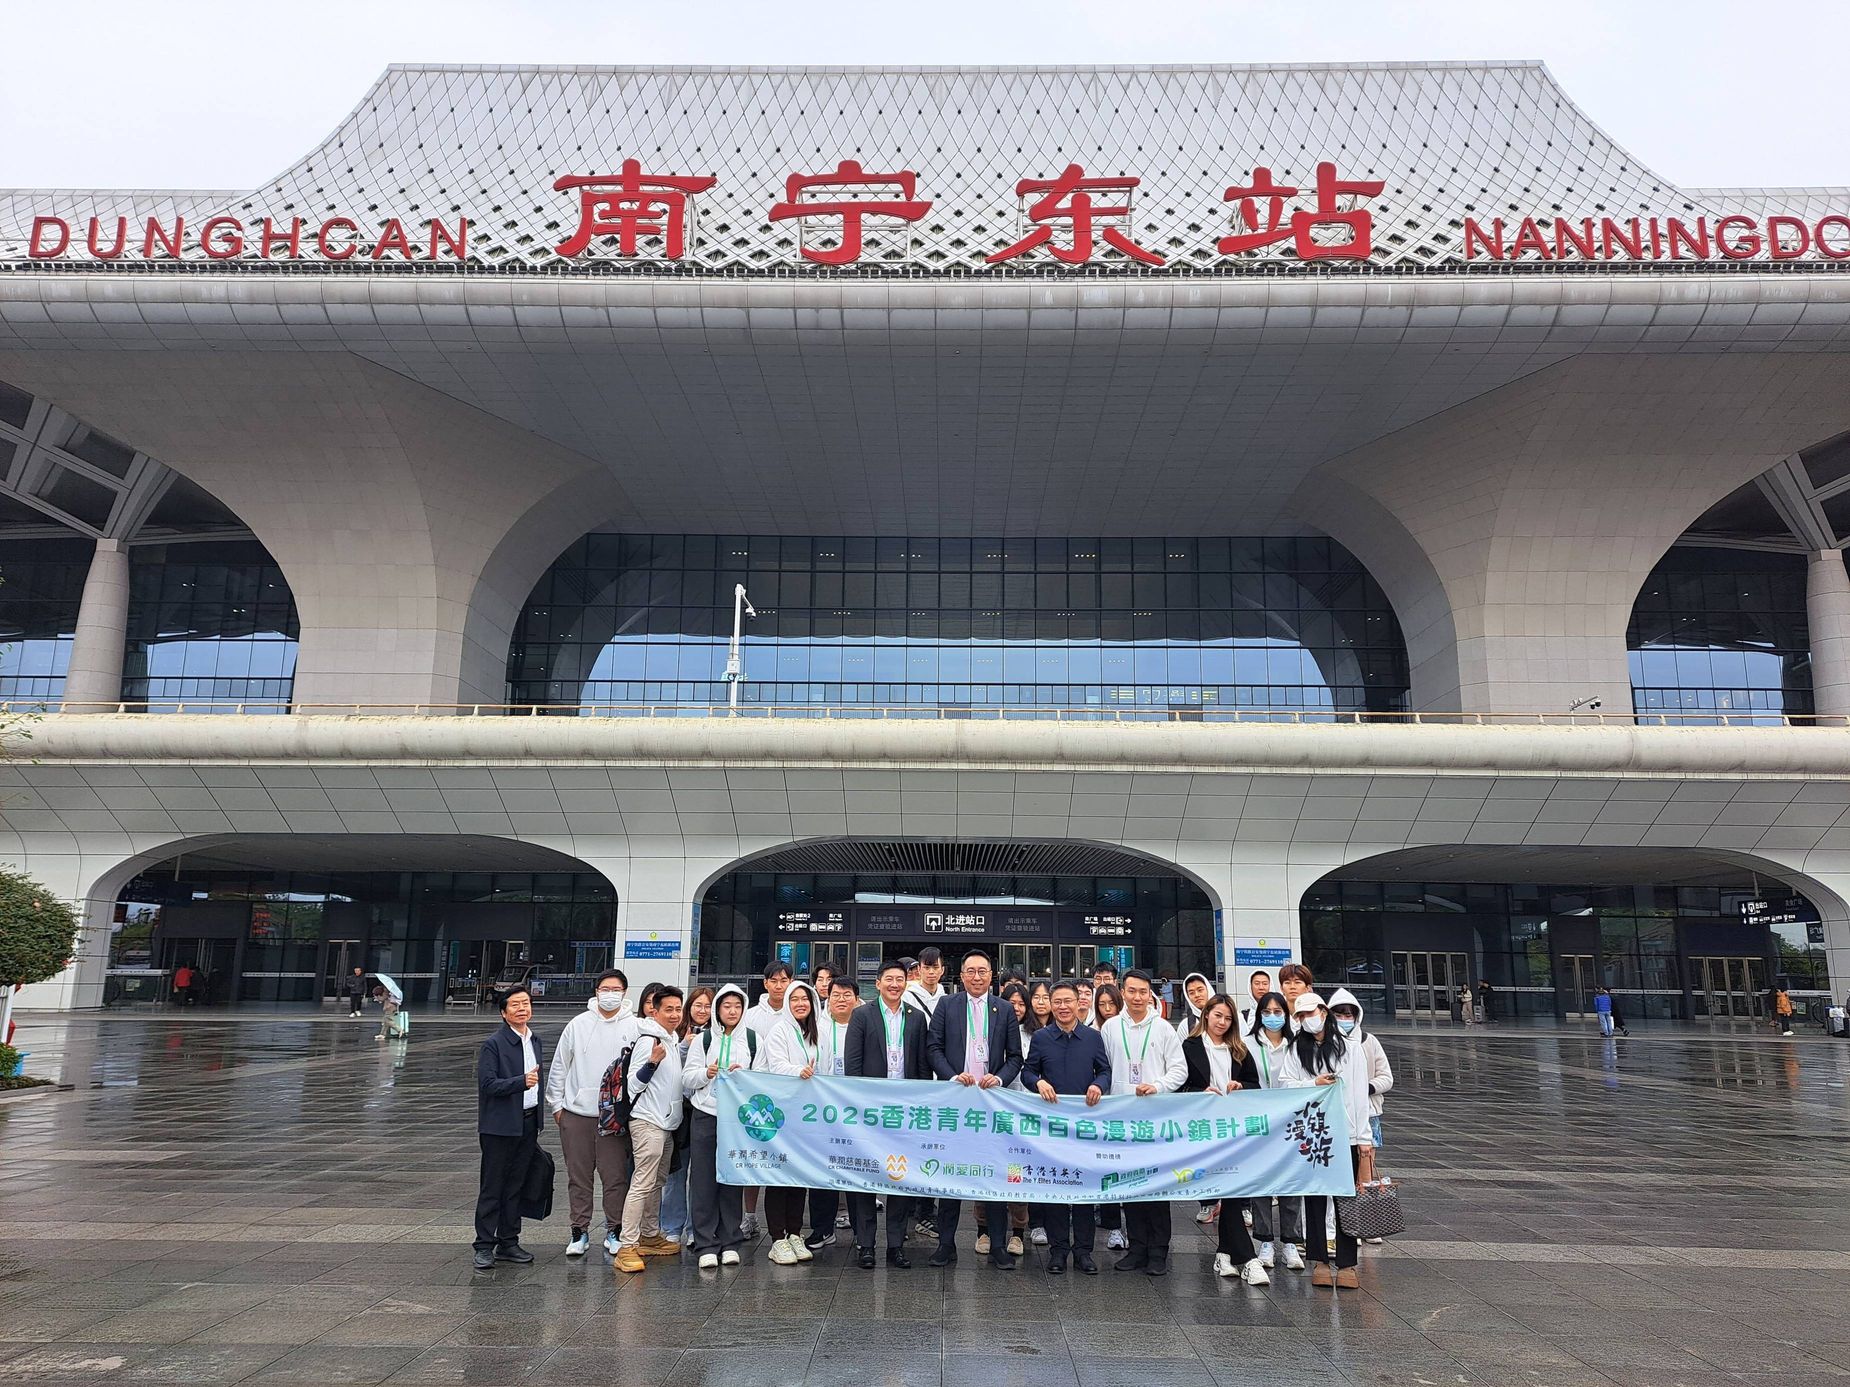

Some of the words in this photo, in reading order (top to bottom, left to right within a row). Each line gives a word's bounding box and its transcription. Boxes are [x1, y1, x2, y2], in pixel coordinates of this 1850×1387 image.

[553, 158, 1385, 267] 南宁东站
[27, 215, 470, 261] DUNGHCAN
[1463, 214, 1850, 261] NANNINGDO
[945, 915, 985, 926] 北进站口
[802, 1103, 1270, 1143] 2025香港青年廣西百色漫遊小鎮計劃
